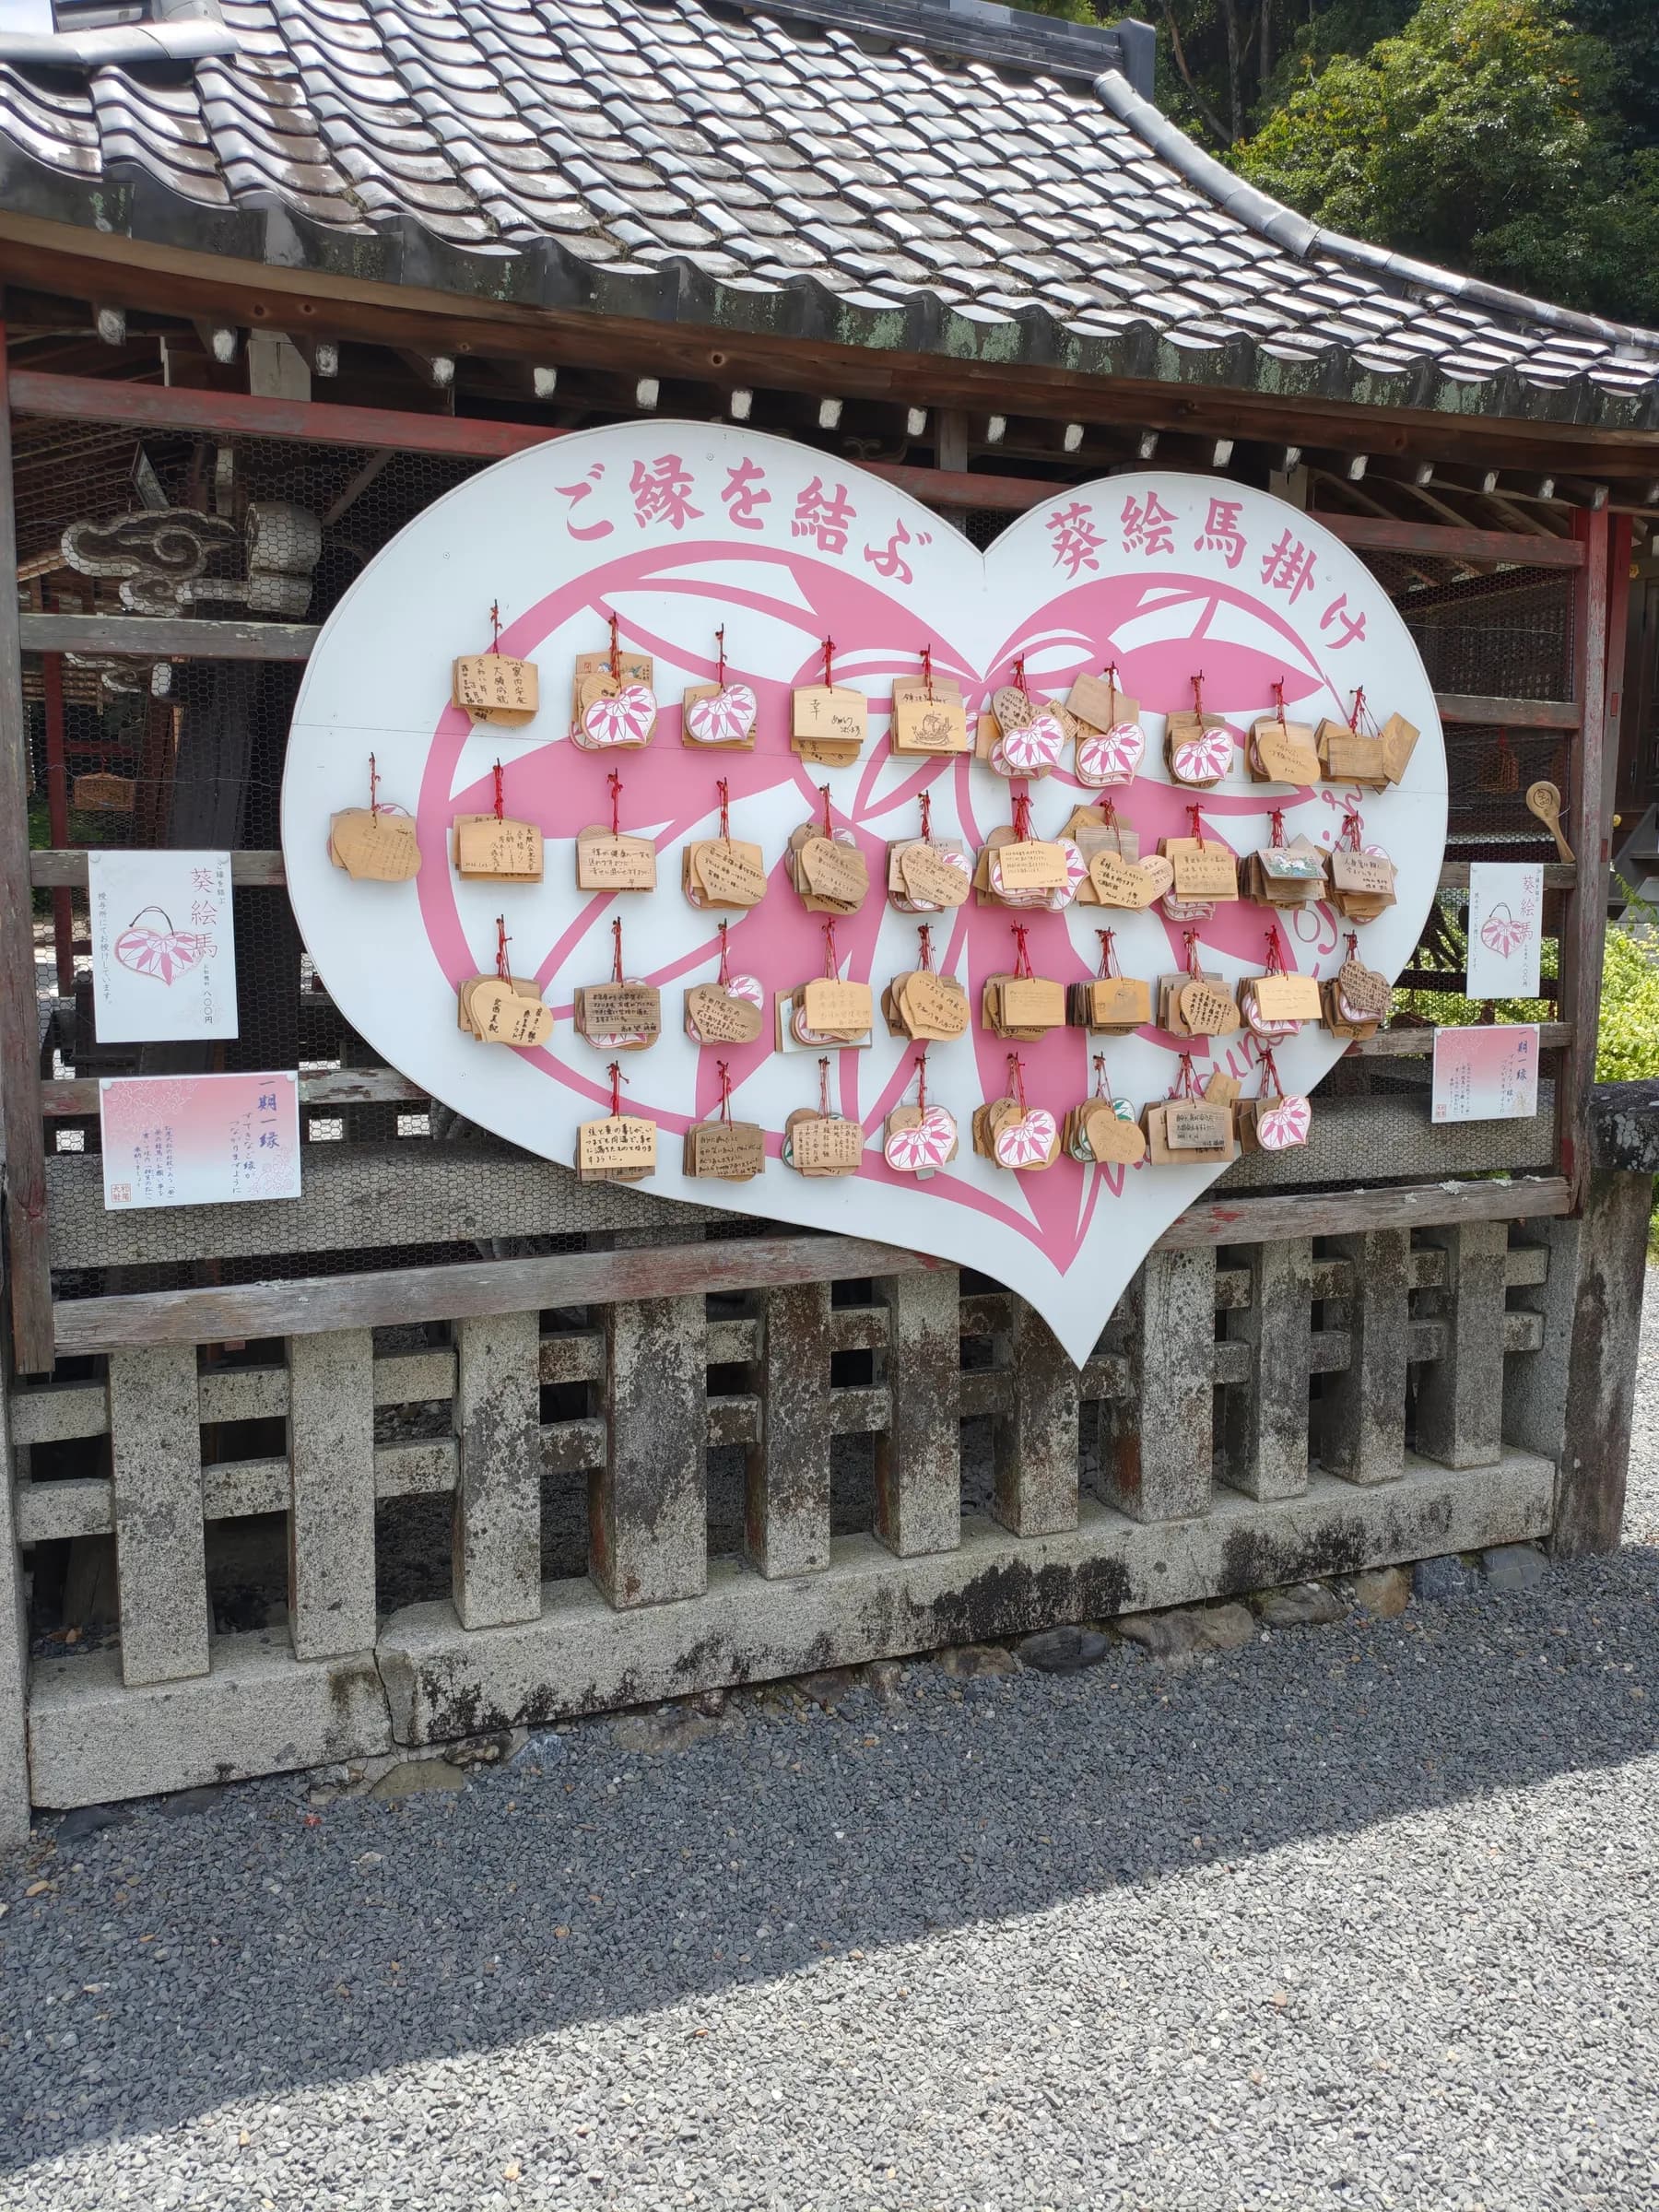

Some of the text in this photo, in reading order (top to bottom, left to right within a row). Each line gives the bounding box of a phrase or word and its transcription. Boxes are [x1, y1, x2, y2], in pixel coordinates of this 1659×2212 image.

[554, 454, 932, 584] ご縁を結ぶ
[1046, 491, 1366, 649] 葵絵馬掛け
[191, 867, 218, 959] 葵絵馬
[1519, 875, 1535, 941] 葵絵馬
[242, 1112, 256, 1181] すてきなご縁が
[257, 1080, 280, 1149] 一期一縁
[229, 1121, 242, 1194] つながりますように
